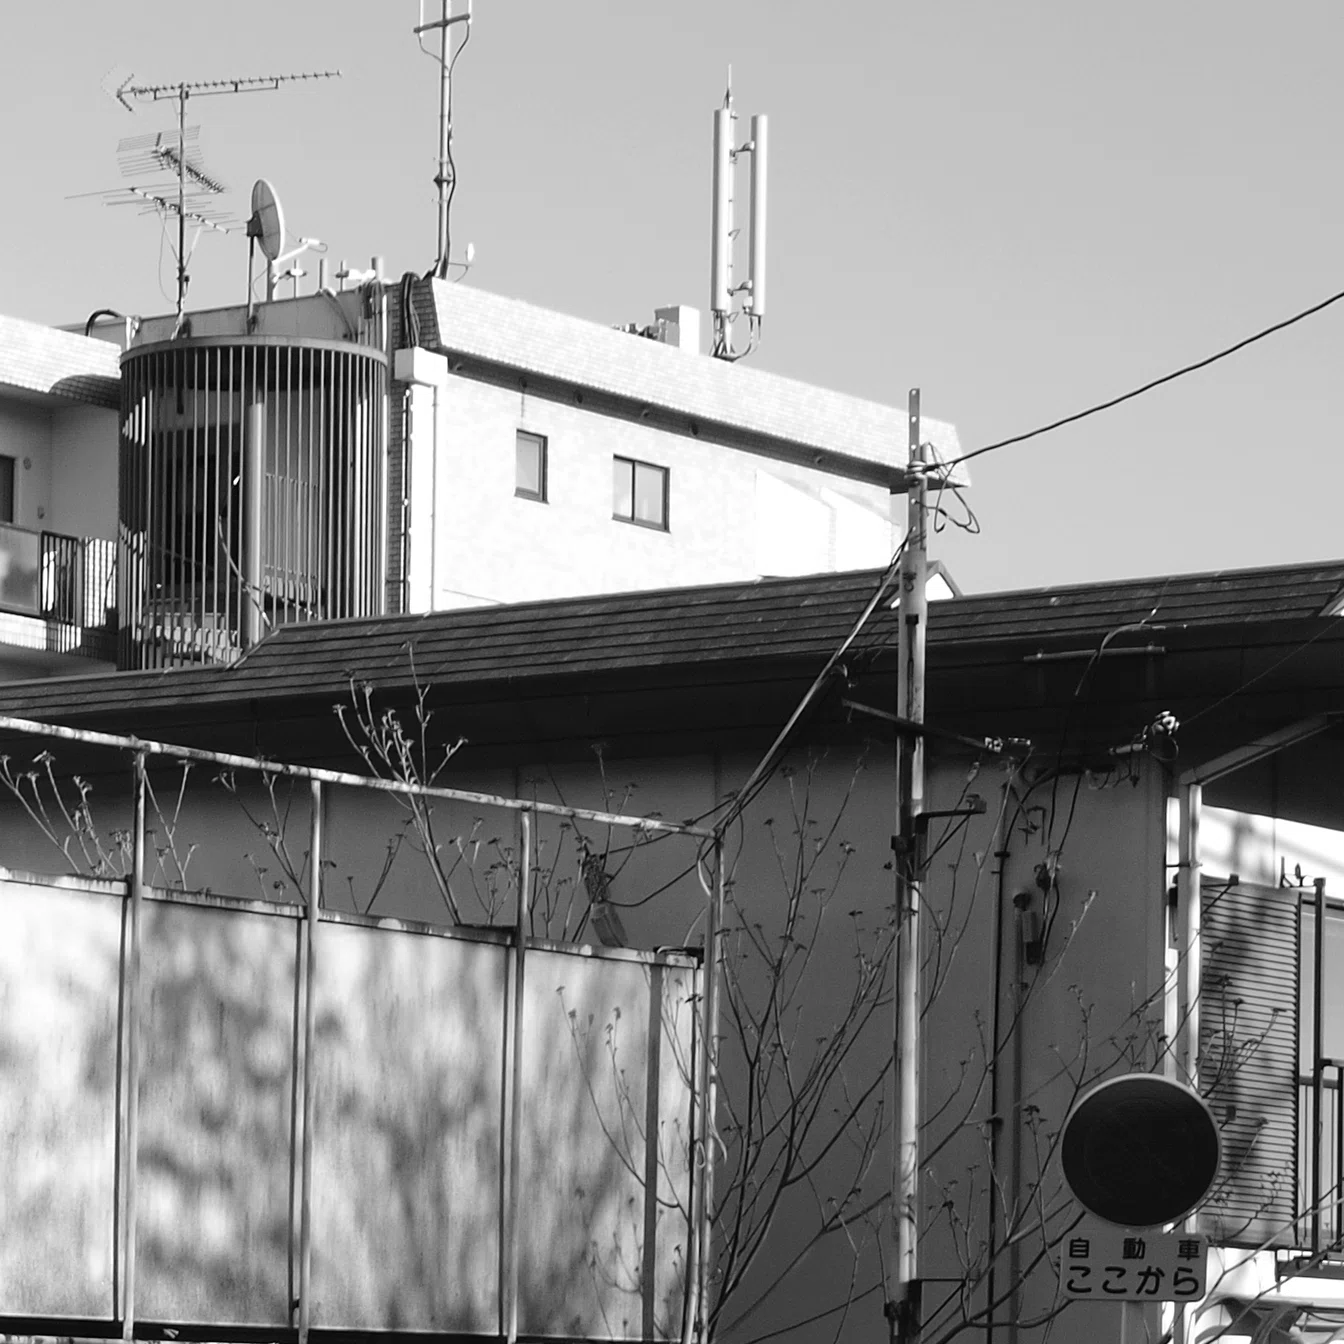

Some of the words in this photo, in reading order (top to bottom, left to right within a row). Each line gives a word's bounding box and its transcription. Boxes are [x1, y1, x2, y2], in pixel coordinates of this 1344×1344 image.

[1069, 1237, 1200, 1261] 自動車
[1067, 1265, 1200, 1296] ここから
